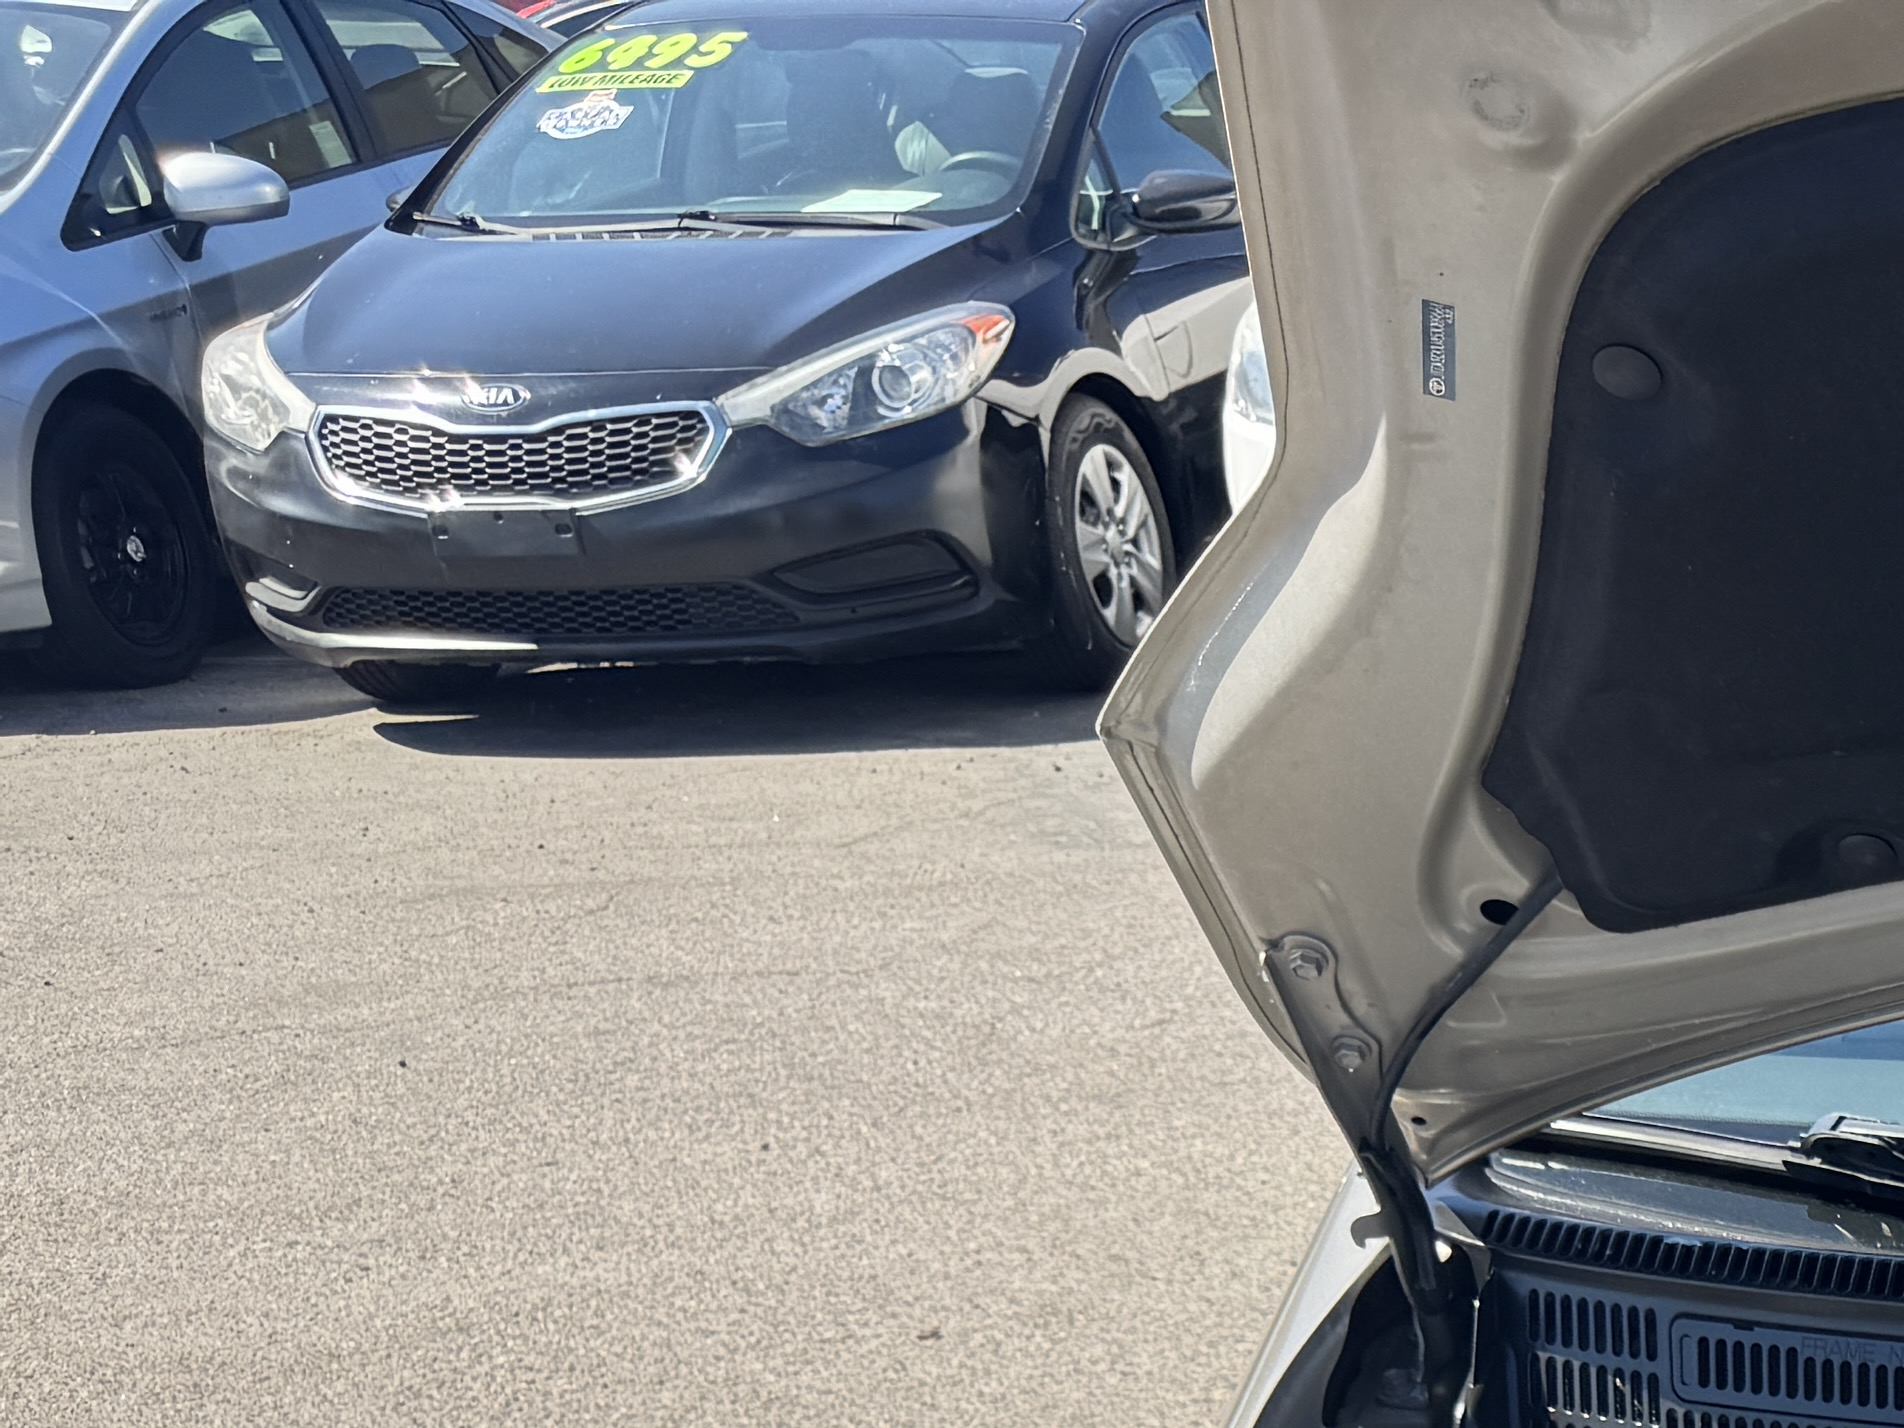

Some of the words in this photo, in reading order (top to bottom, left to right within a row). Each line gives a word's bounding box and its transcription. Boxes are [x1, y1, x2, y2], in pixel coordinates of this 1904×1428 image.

[548, 75, 595, 89] LOW
[592, 72, 686, 87] MILEAGE
[474, 387, 515, 405] KIA
[1802, 1337, 1877, 1364] FRAME
